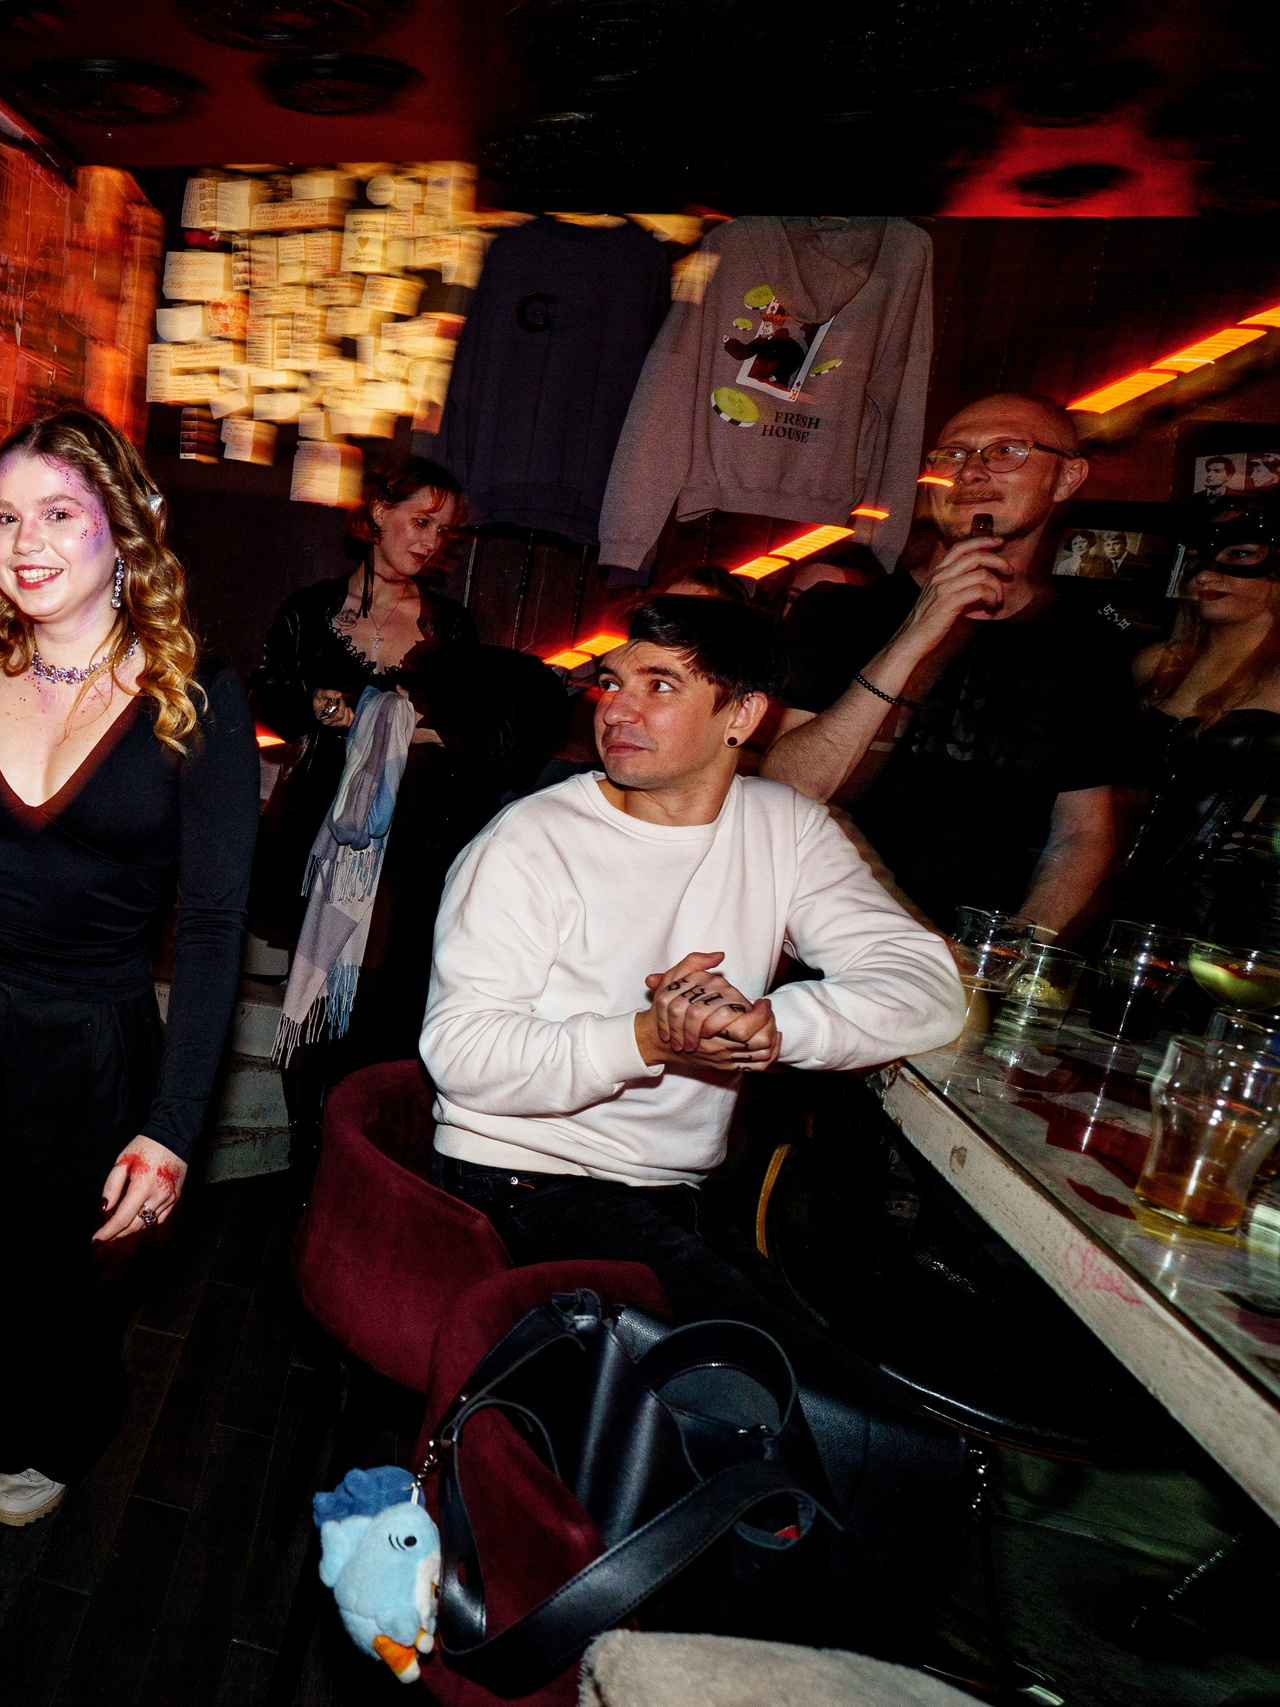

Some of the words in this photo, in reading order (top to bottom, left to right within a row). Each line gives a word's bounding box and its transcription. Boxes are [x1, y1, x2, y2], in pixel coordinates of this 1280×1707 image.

[517, 292, 558, 333] G
[774, 411, 821, 430] FRESH
[760, 424, 810, 444] HOUSE
